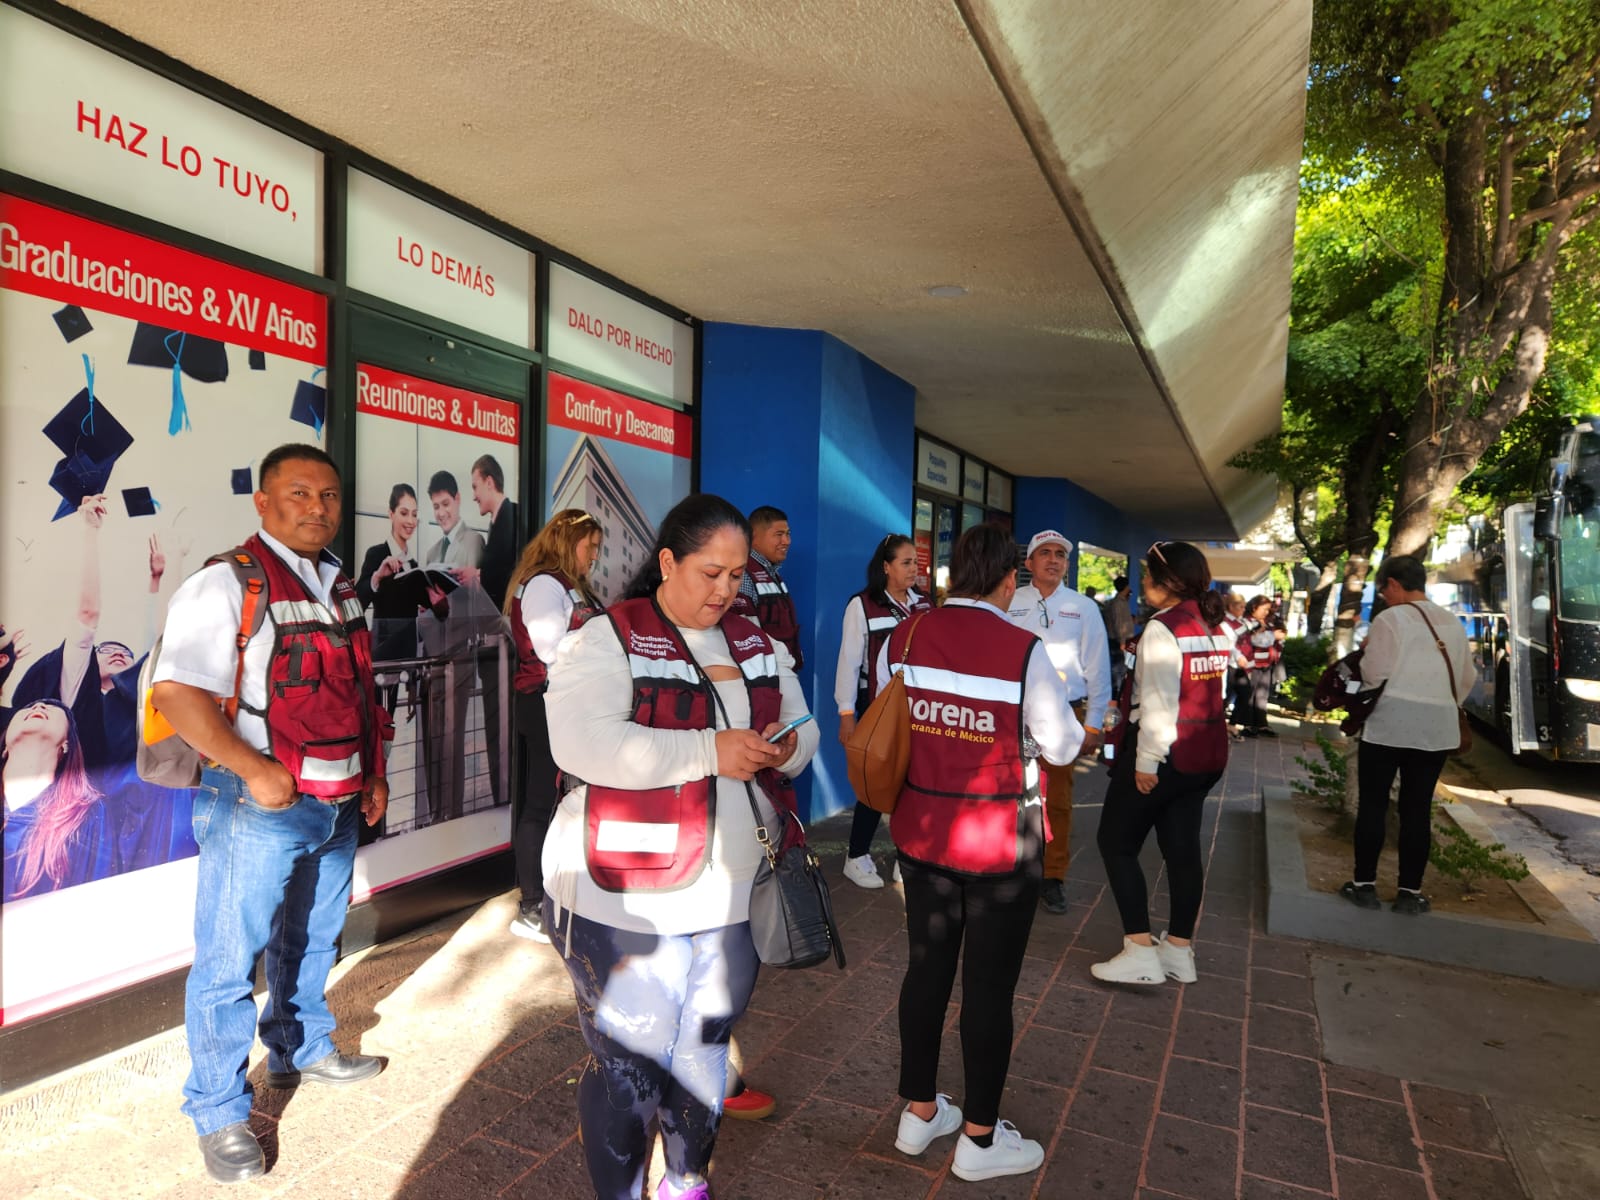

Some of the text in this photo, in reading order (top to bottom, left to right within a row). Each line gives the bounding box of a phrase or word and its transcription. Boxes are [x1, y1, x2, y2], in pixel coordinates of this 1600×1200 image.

[77, 100, 297, 222] HAZ LO TUYO,
[0, 222, 317, 349] Graduaciones & XV Años
[398, 236, 495, 297] LO DEMÁS
[568, 307, 673, 366] DALO POR HECHO
[357, 371, 516, 438] Reuniones & Juntas
[565, 392, 675, 445] Confort y Descanso
[907, 696, 996, 732] orena
[911, 723, 994, 743] eranza de México
